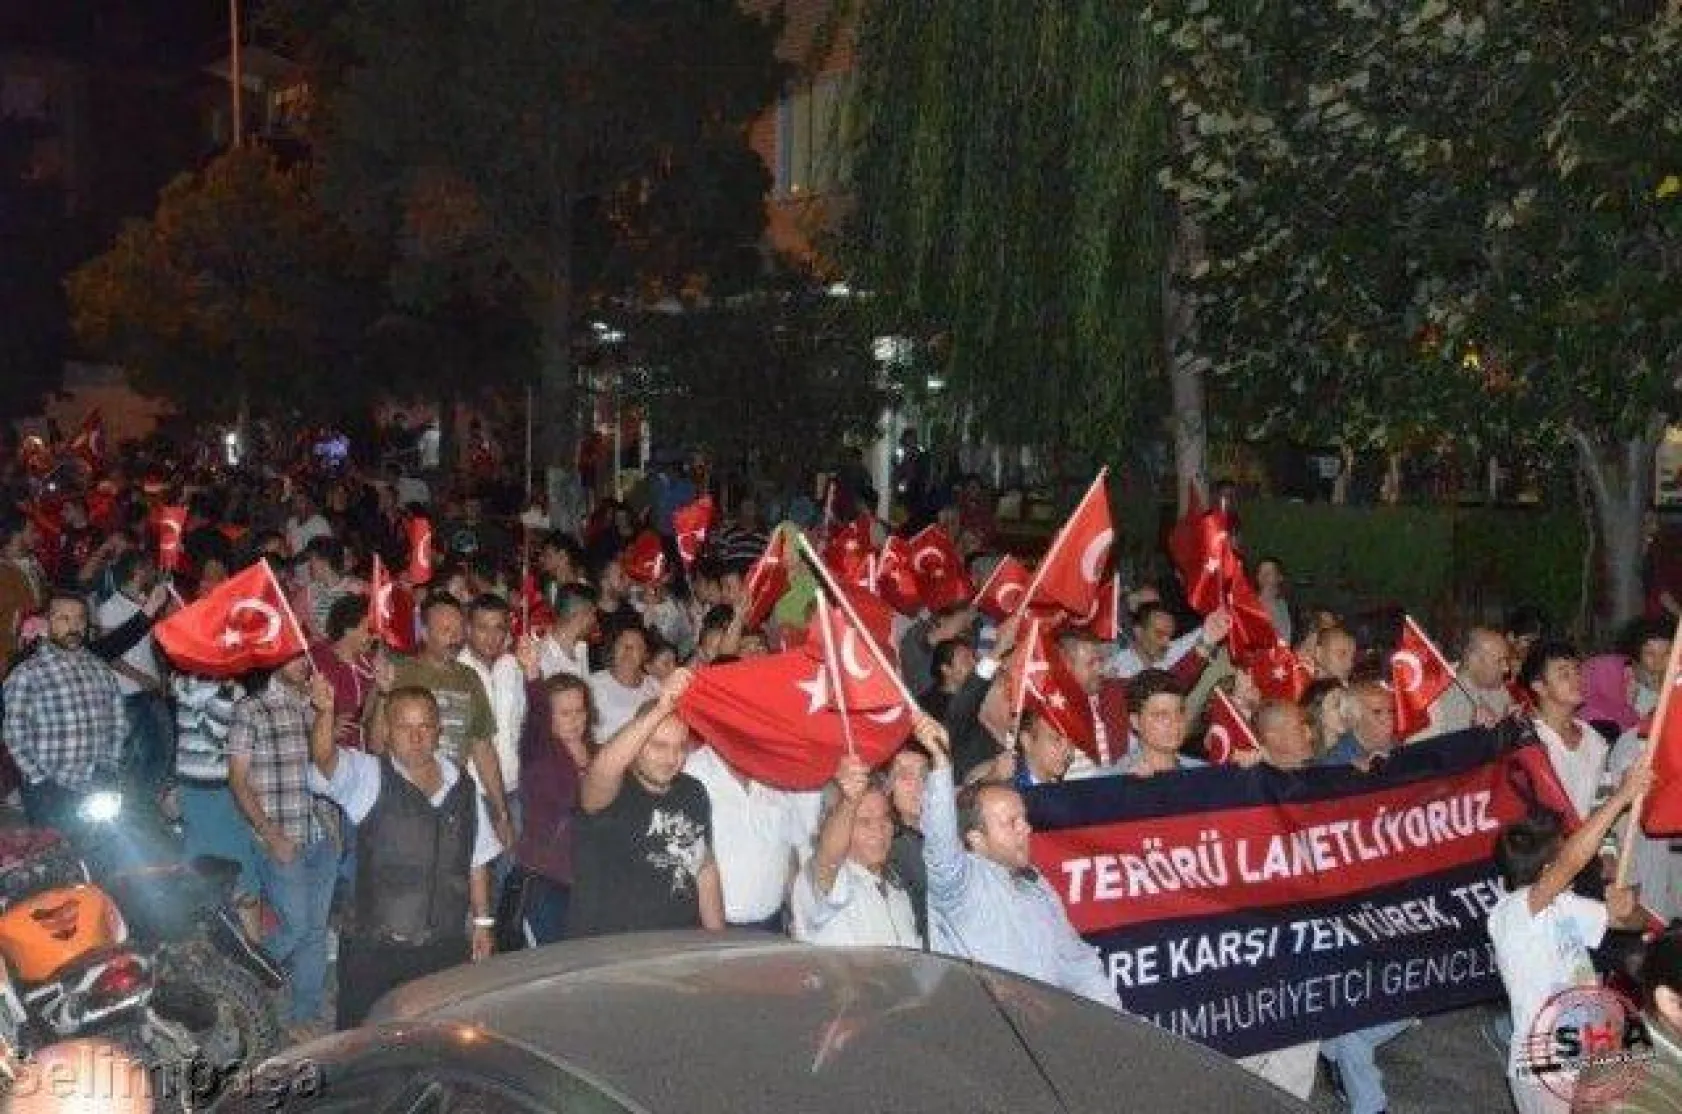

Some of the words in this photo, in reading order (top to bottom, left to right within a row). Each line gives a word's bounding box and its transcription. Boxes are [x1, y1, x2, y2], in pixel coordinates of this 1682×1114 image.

[1062, 829, 1228, 904] TERÖRÜ
[1236, 790, 1498, 884] LANETLİYORUZ
[1167, 926, 1279, 978] KARŞI
[1290, 917, 1360, 952] TEK
[1143, 960, 1373, 1039] UMHURİYETÇİ
